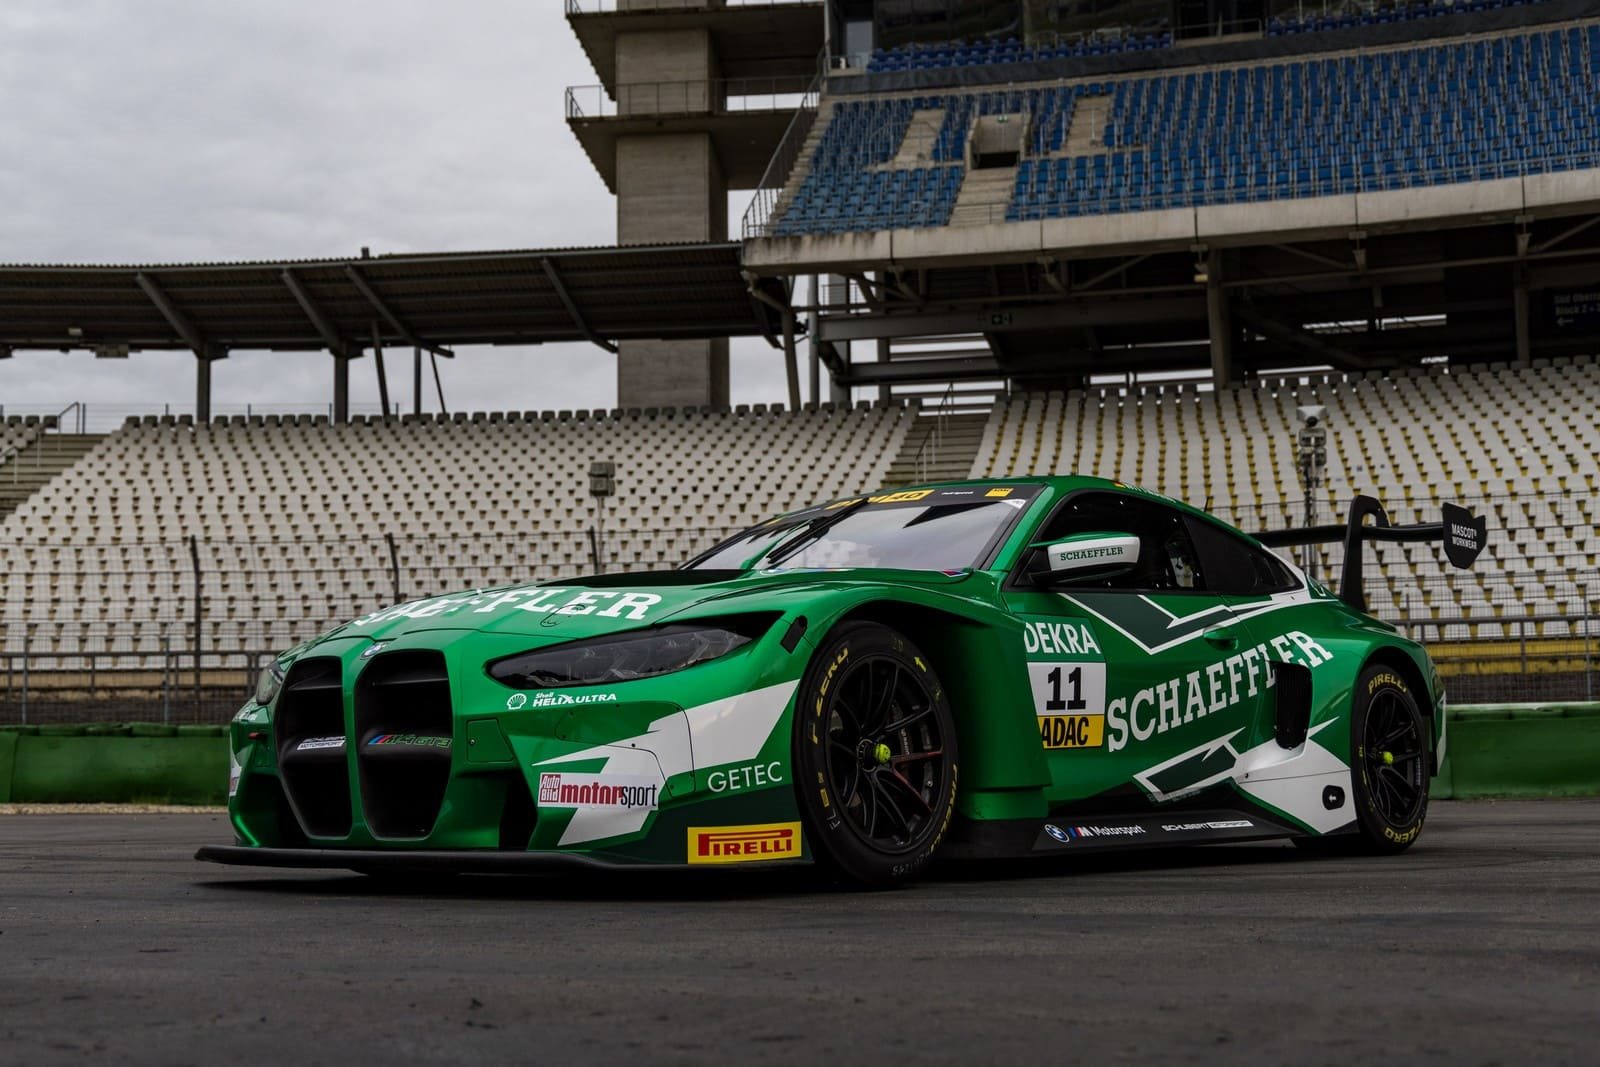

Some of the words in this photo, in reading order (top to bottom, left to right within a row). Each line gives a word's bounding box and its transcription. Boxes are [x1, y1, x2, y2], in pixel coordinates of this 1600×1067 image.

[1060, 547, 1123, 560] SCHAEFFLER
[1023, 622, 1101, 654] DEKRA
[536, 692, 554, 700] Shell
[1045, 666, 1087, 711] 11
[1107, 630, 1334, 752] SCHAEFFLER
[1367, 672, 1408, 695] PIRELLI
[532, 694, 576, 708] HELIX
[575, 693, 617, 704] ULTRA
[1041, 716, 1090, 747] ADAC
[541, 775, 560, 789] Auto
[708, 761, 783, 793] GETEC
[540, 787, 559, 802] Bild
[560, 781, 657, 809] motorsport
[697, 828, 794, 857] PIRELLI
[1091, 824, 1146, 838] Motorsport
